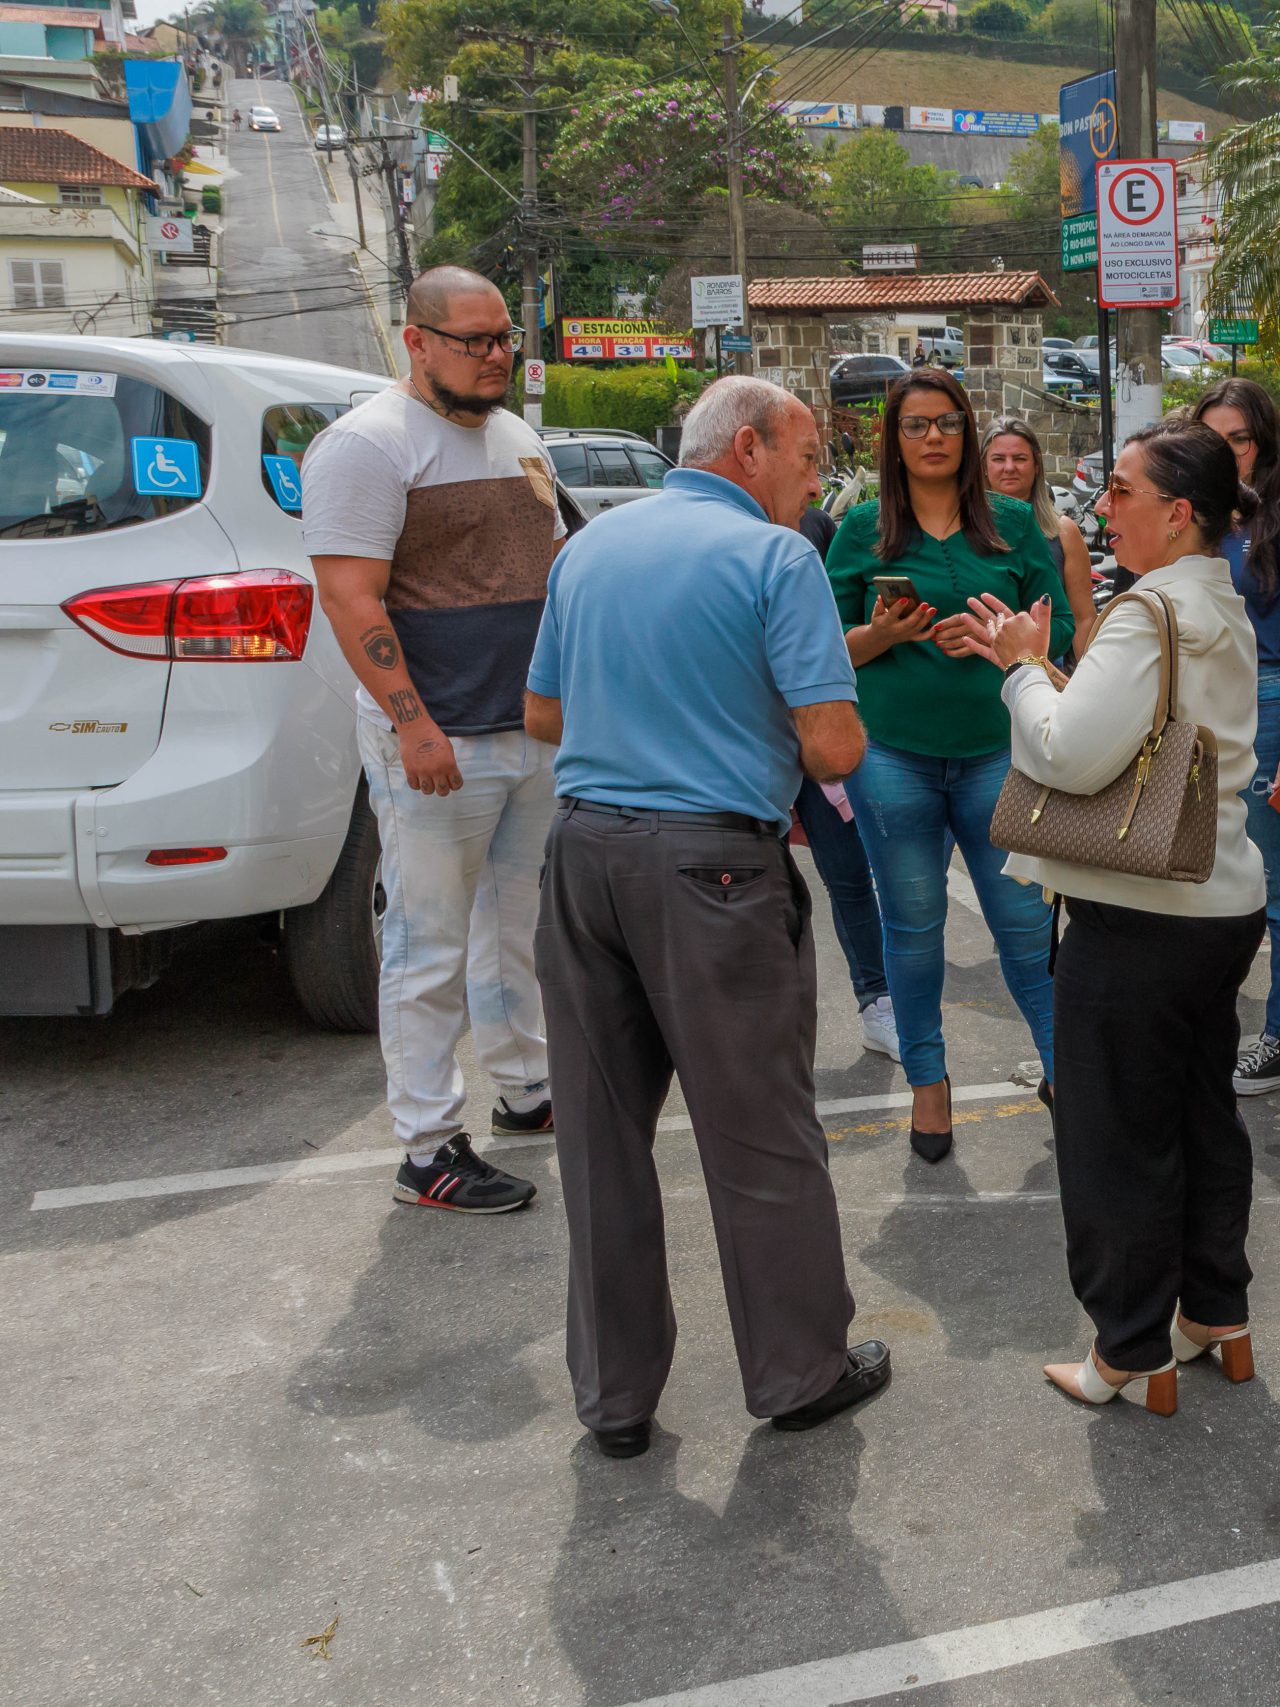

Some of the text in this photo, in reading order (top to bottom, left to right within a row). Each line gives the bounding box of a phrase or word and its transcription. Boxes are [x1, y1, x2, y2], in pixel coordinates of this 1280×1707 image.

[1060, 121, 1073, 138] BOM
[1126, 180, 1146, 212] E
[1069, 219, 1097, 235] PETRÓPOLI
[1070, 236, 1096, 250] RIO-BAHIA
[866, 250, 911, 265] HOTEL
[1070, 253, 1085, 265] NOVA
[1104, 258, 1172, 268] USO EXCLUSIVO
[1105, 271, 1172, 280] MOTOCICLETAS
[583, 322, 657, 334] ESTACIONAM
[580, 337, 602, 345] HORA
[613, 335, 645, 345] FRAÇÃO
